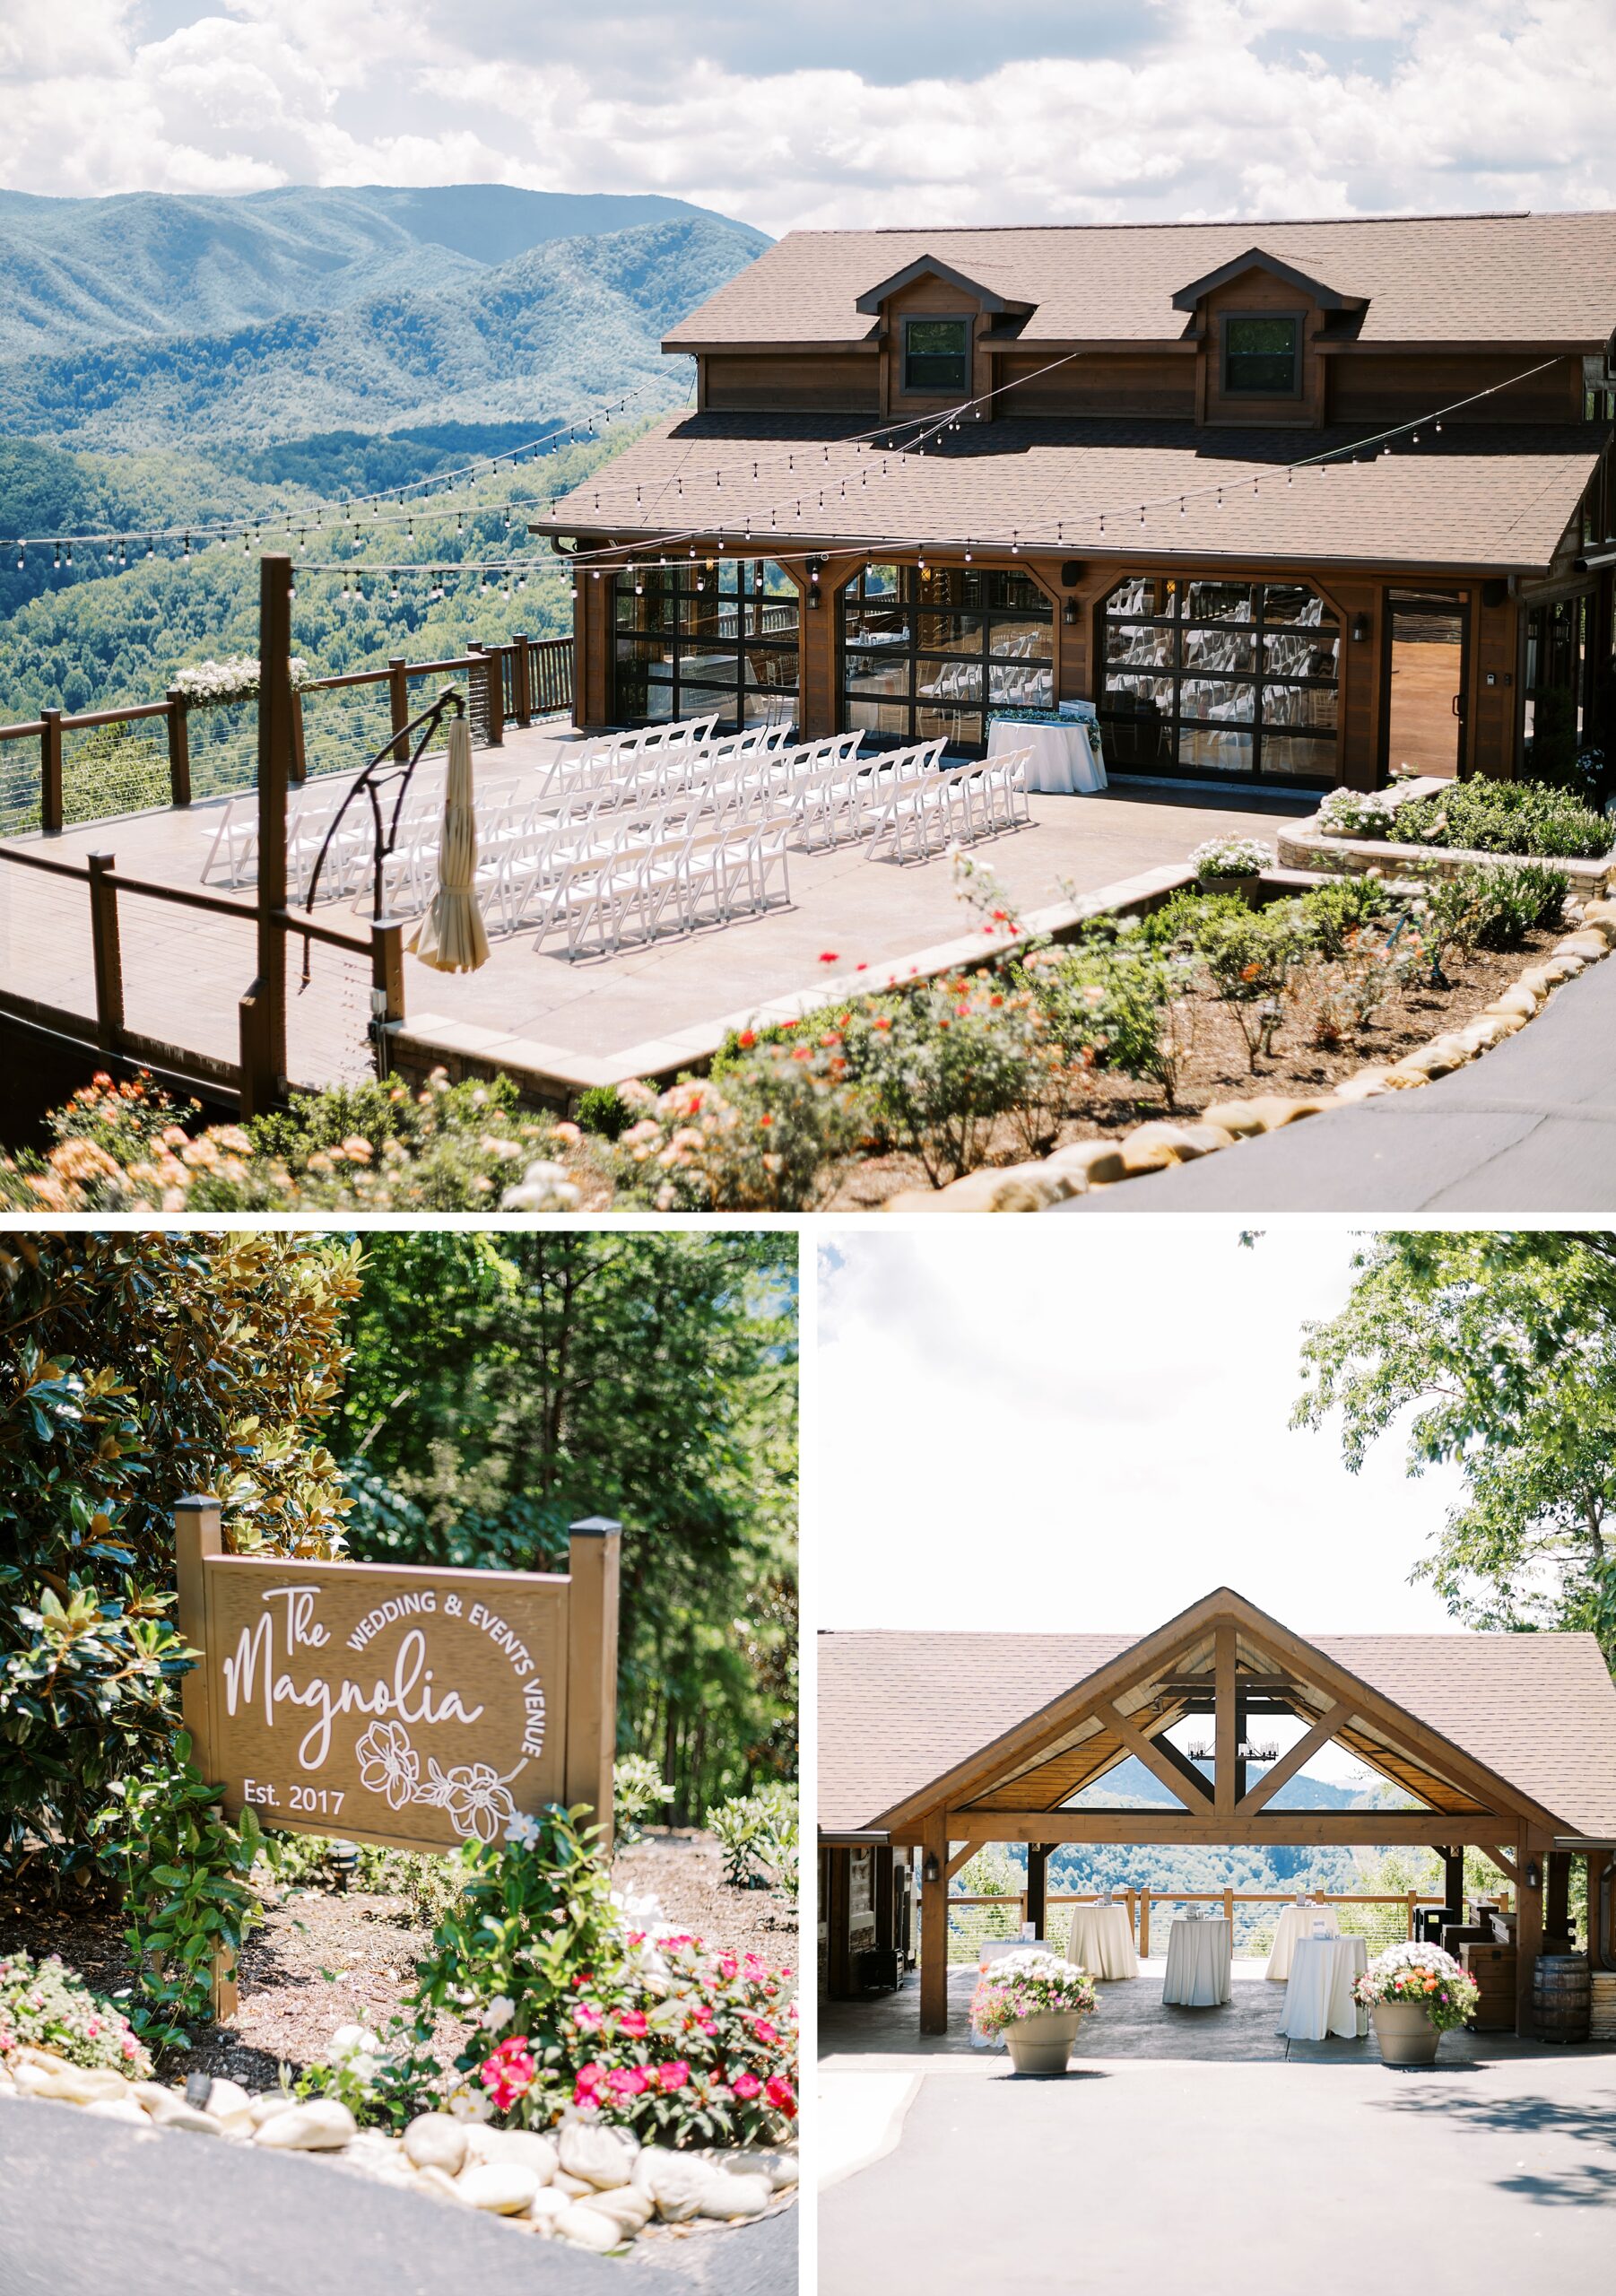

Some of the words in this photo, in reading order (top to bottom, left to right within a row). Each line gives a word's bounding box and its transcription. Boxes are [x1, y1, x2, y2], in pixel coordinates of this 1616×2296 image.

[263, 1587, 330, 1655] The
[346, 1591, 436, 1651] WEDDING
[444, 1594, 463, 1616] &
[469, 1604, 534, 1674] EVENTS
[522, 1679, 545, 1757] VENUE
[223, 1613, 483, 1770] Magnolia
[244, 1780, 280, 1805] Est.
[290, 1787, 345, 1814] 2017
